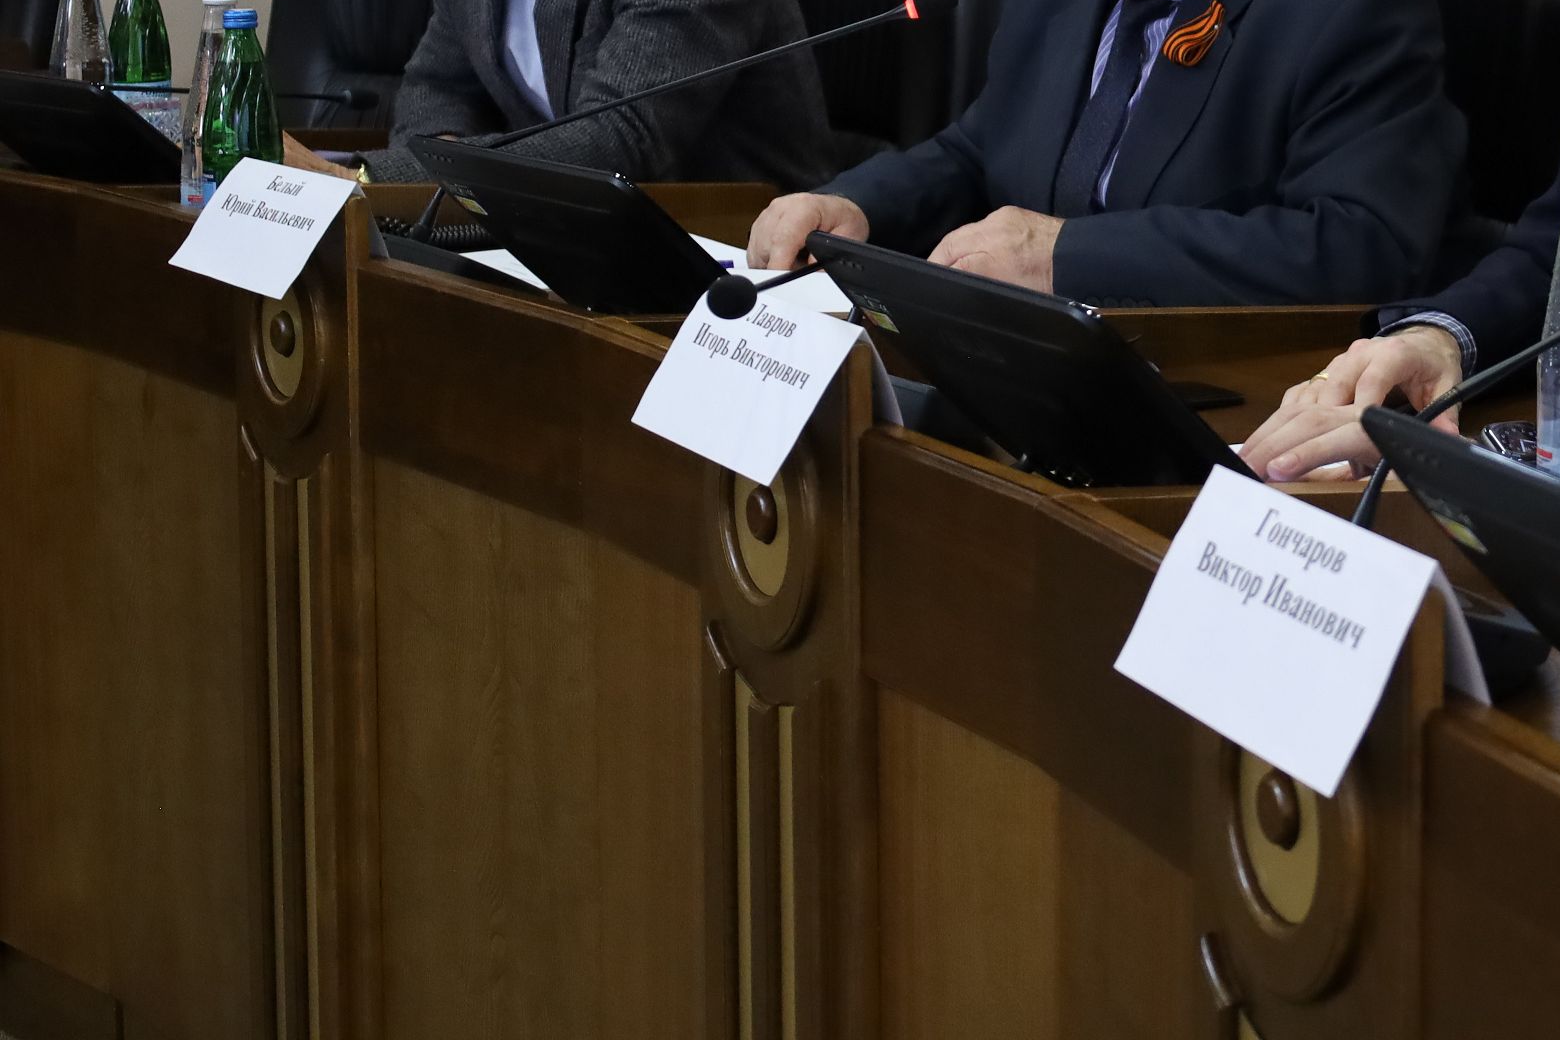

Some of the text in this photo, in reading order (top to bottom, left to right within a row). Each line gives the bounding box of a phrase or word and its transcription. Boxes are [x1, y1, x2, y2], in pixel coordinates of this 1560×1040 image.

[266, 175, 306, 196] Белый
[221, 193, 315, 231] Юрий Васильевич
[746, 303, 797, 338] Лавров
[692, 322, 810, 390] Игорь Викторович
[1254, 508, 1348, 573] Гончаров
[1197, 541, 1367, 650] Виктор Иванович
